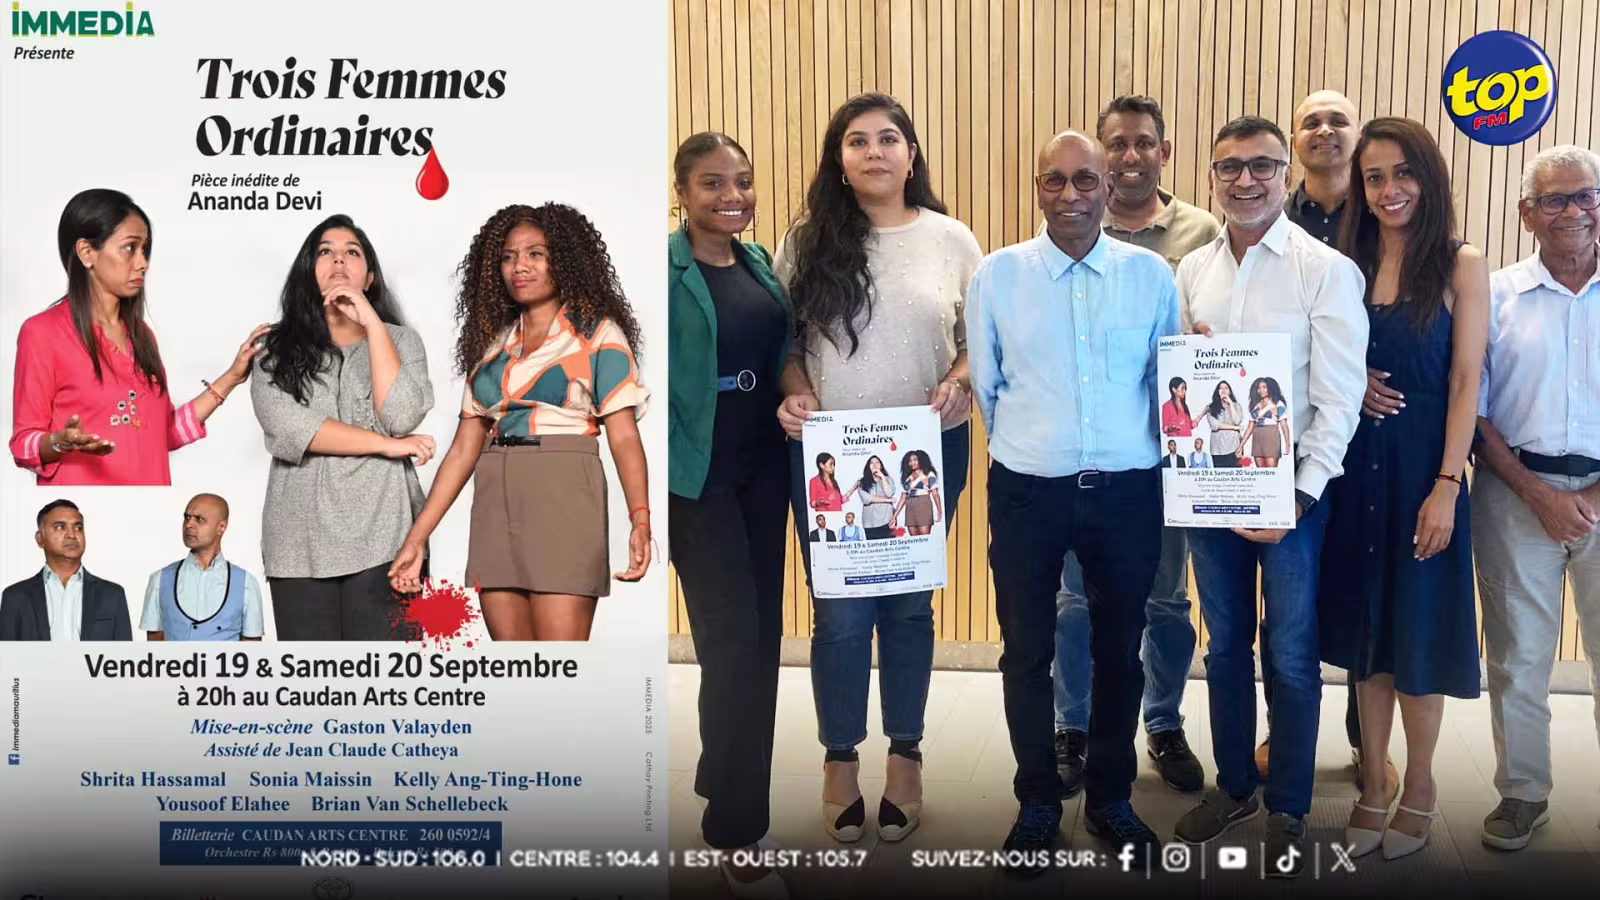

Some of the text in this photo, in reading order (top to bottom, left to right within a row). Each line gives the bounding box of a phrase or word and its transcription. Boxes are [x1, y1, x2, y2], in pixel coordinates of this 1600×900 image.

[12, 1, 155, 37] IMMEDIA
[14, 46, 75, 60] Présente
[196, 56, 507, 100] Trois Femmes
[195, 114, 434, 158] Ordinaires
[191, 172, 301, 187] Pièce inédite de
[187, 191, 322, 211] Ananda Devi
[1194, 347, 1259, 358] Trois Femmes
[1194, 359, 1244, 370] Ordinaires
[842, 422, 909, 435] Trois Femmes
[842, 434, 894, 446] Ordinaires
[1214, 469, 1235, 477] Samedi
[1235, 469, 1244, 477] 20
[1244, 469, 1276, 478] Septembre
[84, 652, 578, 684] Vendredi 19 & Samedi 20 Septembre
[177, 686, 486, 707] à 20h au Caudan Arts Centre
[191, 718, 472, 739] Mise-en-scène Gaston Valayden
[203, 742, 459, 761] Assisté de Jean Claude Catheya
[80, 771, 226, 787] Shrita Hassamal
[249, 771, 372, 787] Sonia Maissin
[394, 771, 582, 791] Kelly Ang-Ting-Hone
[156, 795, 290, 812] Yousoof Elahee
[311, 795, 509, 812] Brian Van Schellebeck
[171, 828, 409, 842] Billetterie CAUDAN ARTS CENTRE
[419, 828, 491, 842] 260 0592/4
[204, 846, 260, 858] Orchestre
[262, 847, 278, 858] Rs
